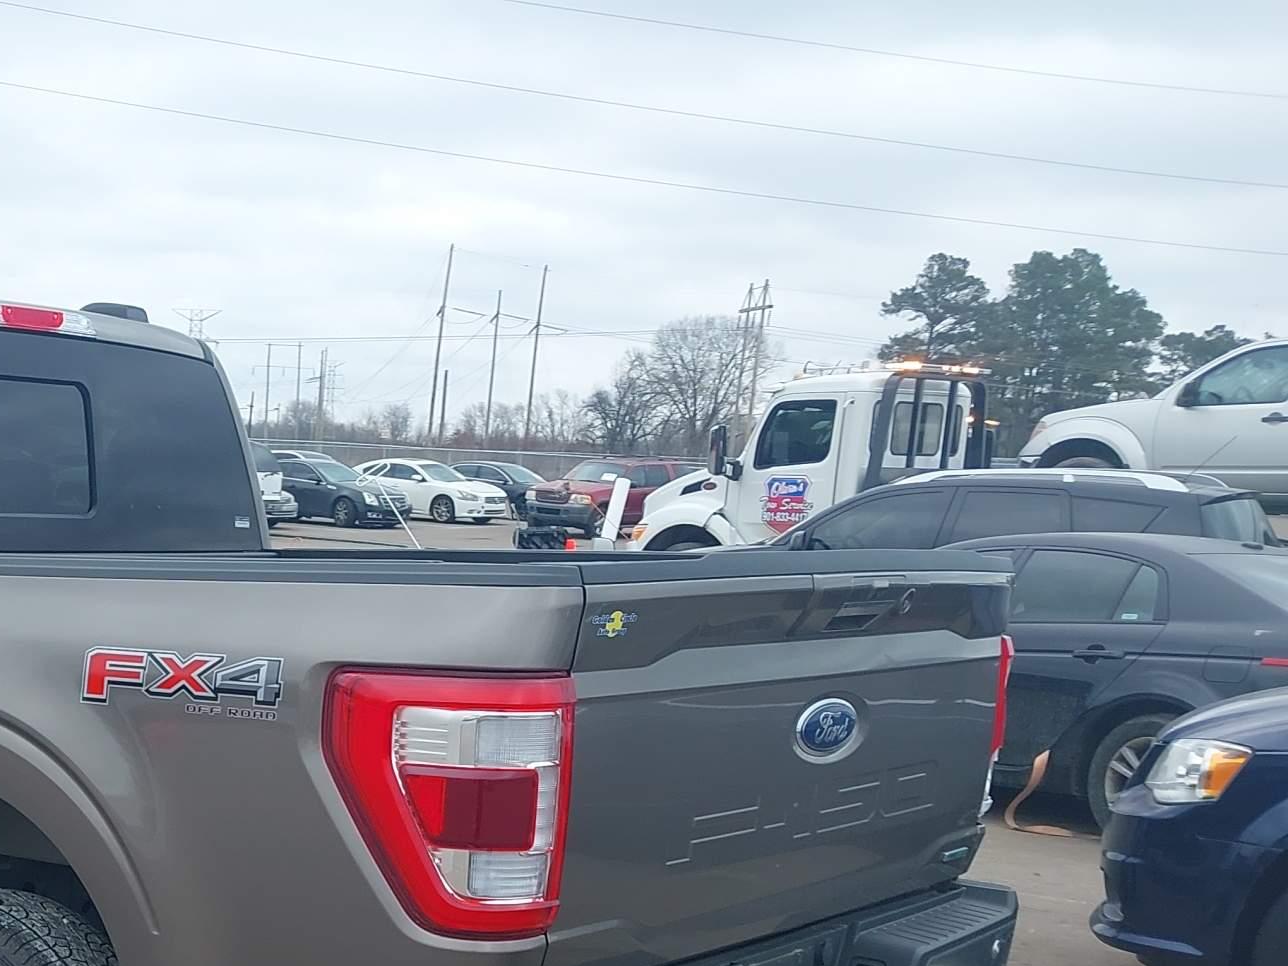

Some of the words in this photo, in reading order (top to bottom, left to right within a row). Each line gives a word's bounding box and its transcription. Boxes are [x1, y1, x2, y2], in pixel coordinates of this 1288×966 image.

[80, 646, 283, 708] FX4
[185, 703, 221, 715] OFF
[227, 706, 278, 721] ROAD
[815, 711, 849, 744] Ford
